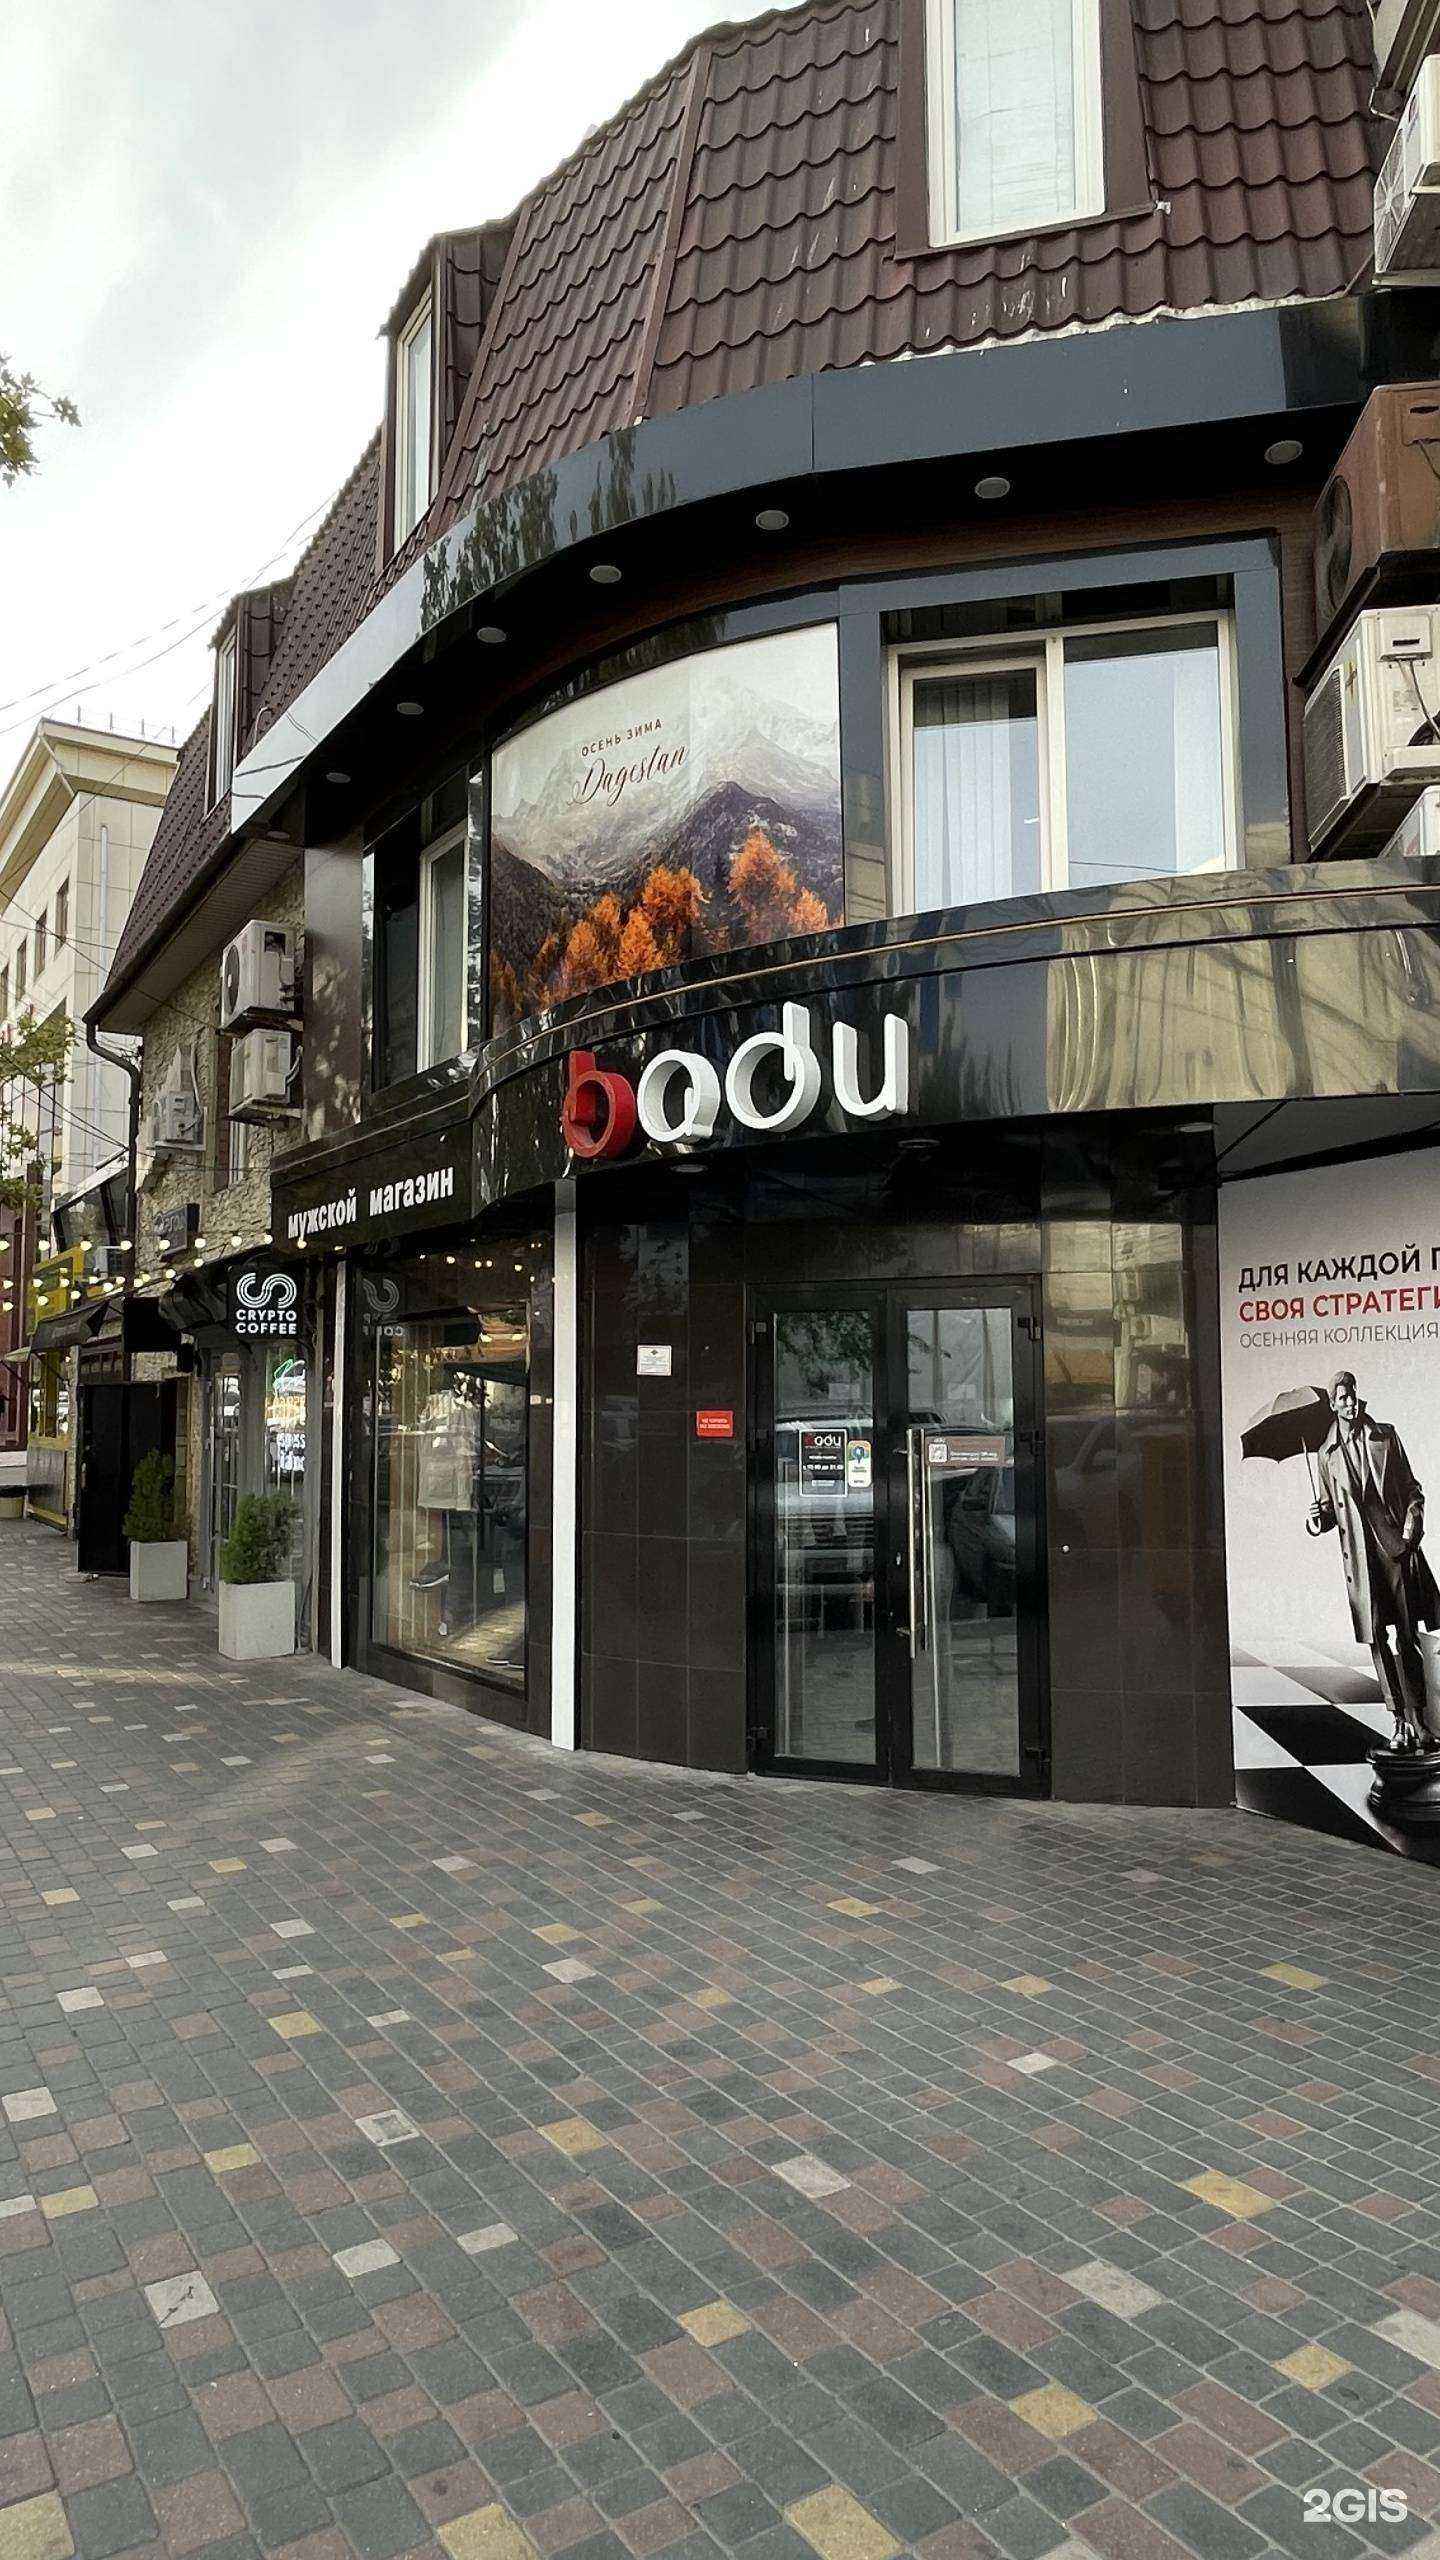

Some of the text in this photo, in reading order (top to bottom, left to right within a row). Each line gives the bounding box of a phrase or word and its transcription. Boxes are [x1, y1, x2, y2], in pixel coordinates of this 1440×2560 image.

[581, 718, 662, 757] ОСЕНЬ ЗИМА
[566, 744, 686, 807] Dagestan
[288, 1166, 454, 1242] мужской магазин
[1238, 1263, 1288, 1293] ДЛЯ
[1297, 1243, 1420, 1283] КАЖДОЙ
[236, 1309, 297, 1322] CRYPTO
[1239, 1297, 1304, 1322] СВОЯ
[235, 1323, 297, 1335] COFFEE
[1239, 1322, 1439, 1349] ОСЕННЯЯ КОЛЛЕКЦИЯ
